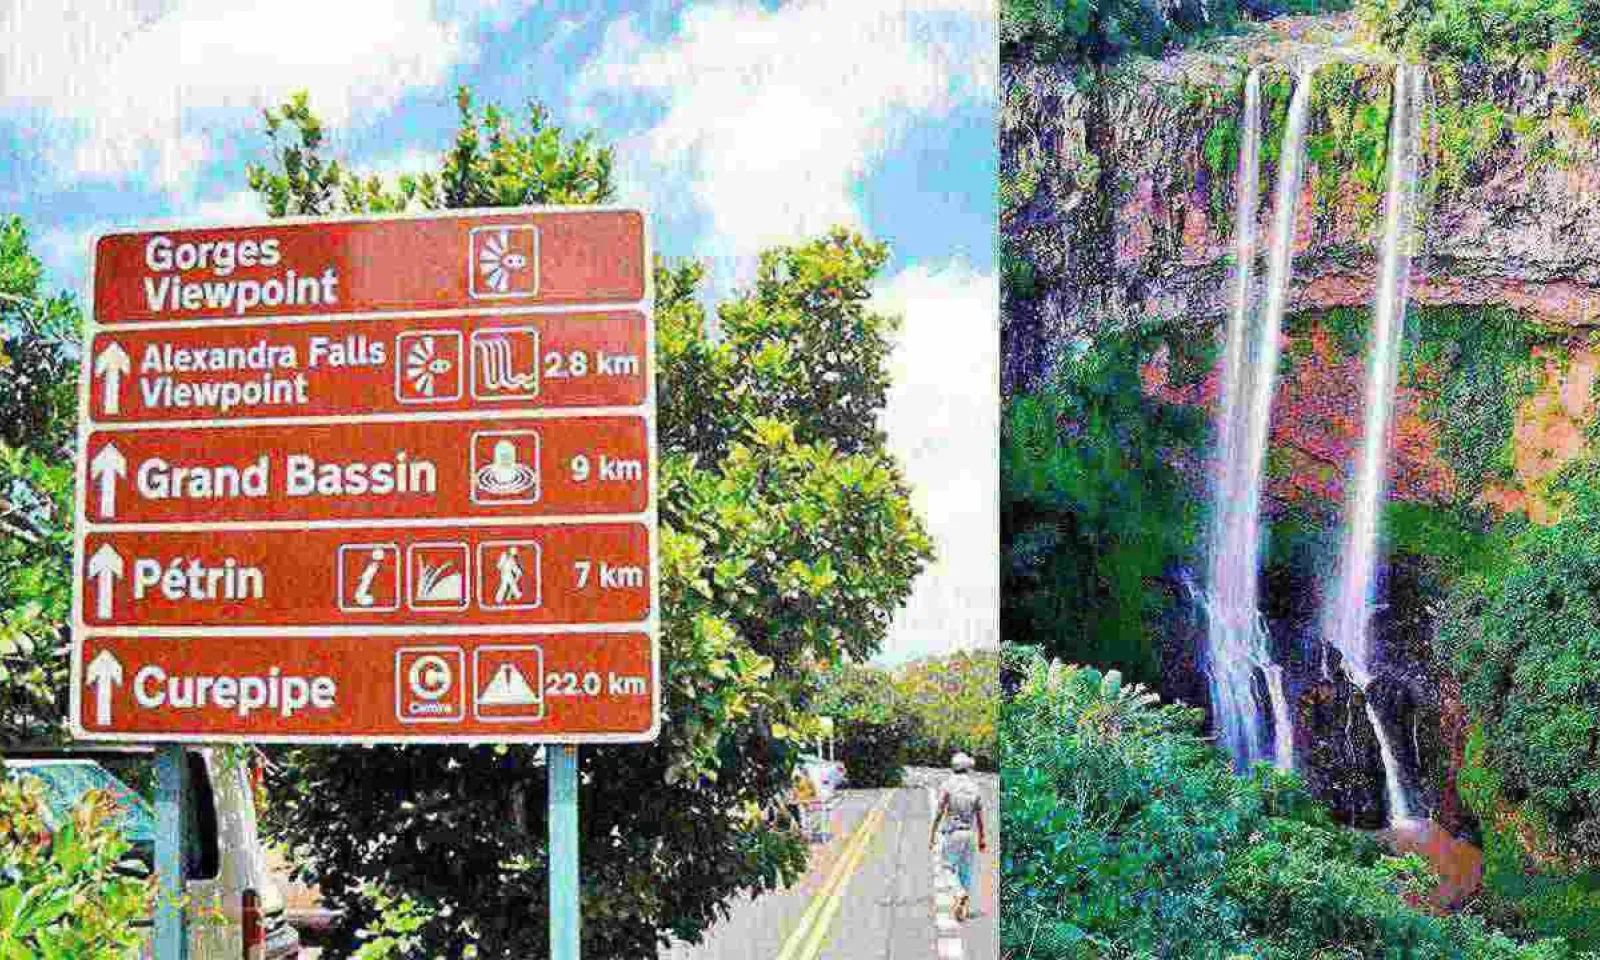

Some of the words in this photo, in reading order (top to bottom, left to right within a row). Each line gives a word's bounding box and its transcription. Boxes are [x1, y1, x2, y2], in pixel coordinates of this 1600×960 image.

[145, 235, 281, 274] Gorges
[143, 269, 338, 313] Viewpoint
[142, 339, 297, 374] Alexandra
[310, 336, 386, 370] Falls
[597, 350, 640, 377] km
[140, 373, 307, 410] Viewpoint
[136, 455, 268, 500] Grand
[285, 451, 437, 496] Bassin
[571, 455, 590, 482] 9
[599, 456, 643, 482] km
[133, 558, 264, 602] Pétrin
[574, 561, 591, 590] 7
[599, 562, 643, 590] km
[133, 665, 337, 716] Curepipe
[544, 672, 600, 698] 22.0
[607, 670, 647, 697] km
